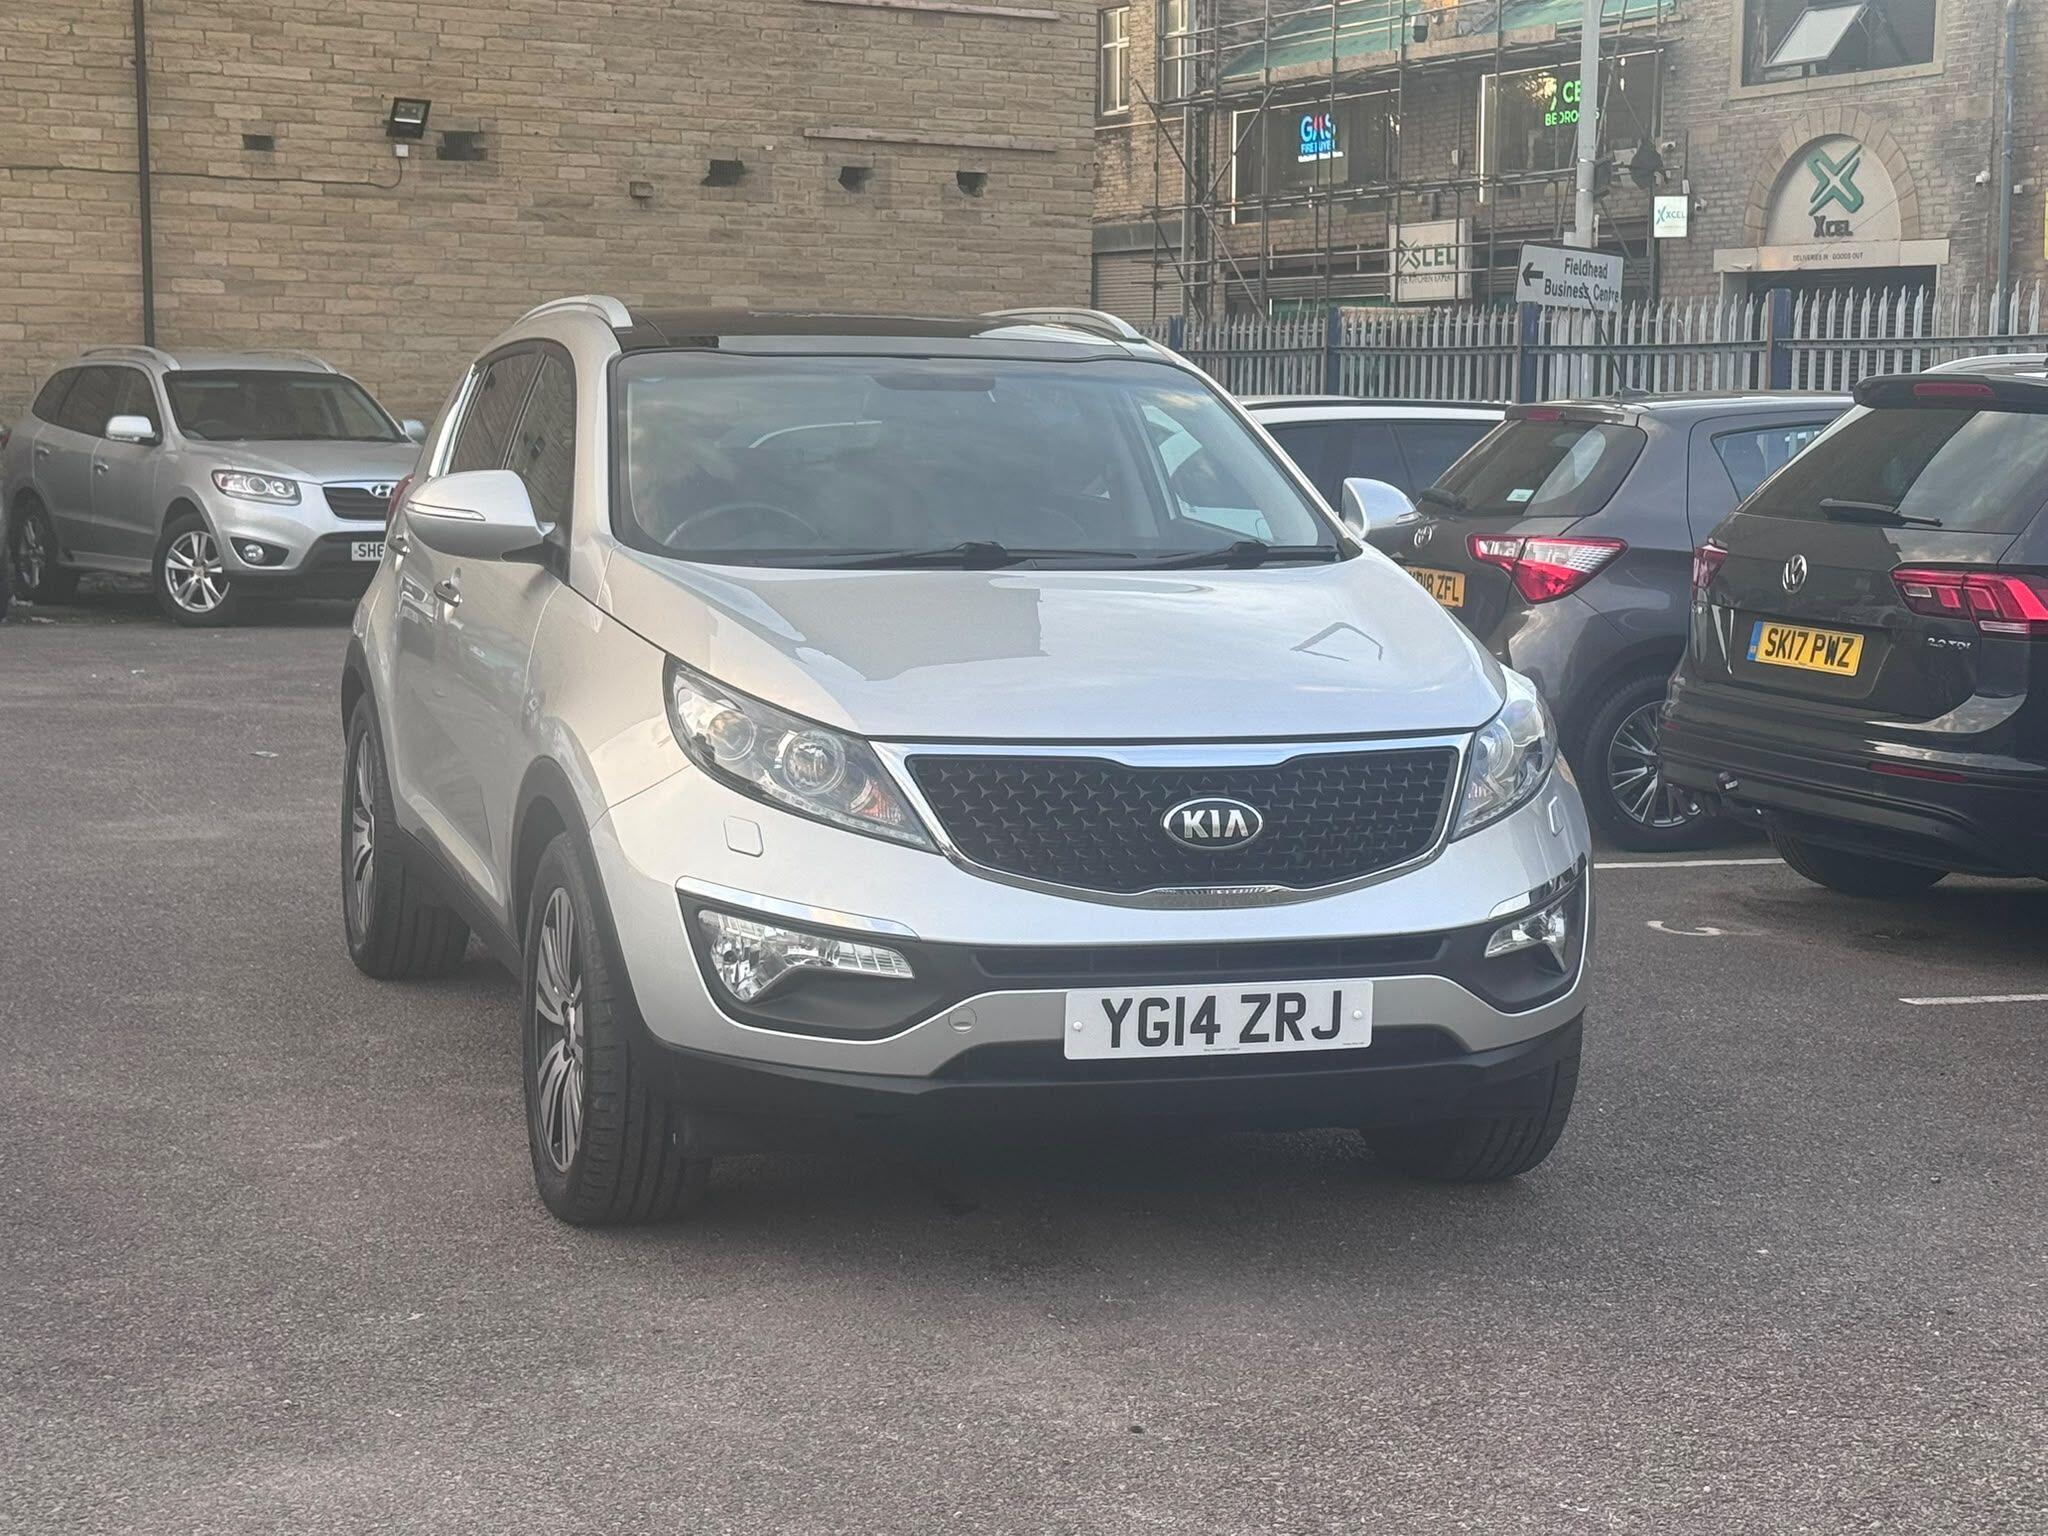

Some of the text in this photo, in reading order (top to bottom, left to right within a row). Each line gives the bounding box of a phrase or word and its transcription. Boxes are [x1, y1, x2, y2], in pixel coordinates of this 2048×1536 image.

[1300, 113, 1336, 142] GAS
[1813, 215, 1854, 237] XCEL
[1564, 257, 1608, 279] Fieldhead
[1544, 278, 1620, 303] Business Centre
[1436, 574, 1459, 602] ZFL
[1765, 627, 1855, 668] SK17 PWZ
[1182, 809, 1249, 838] KIA
[1101, 990, 1342, 1048] YG14 ZRJ
